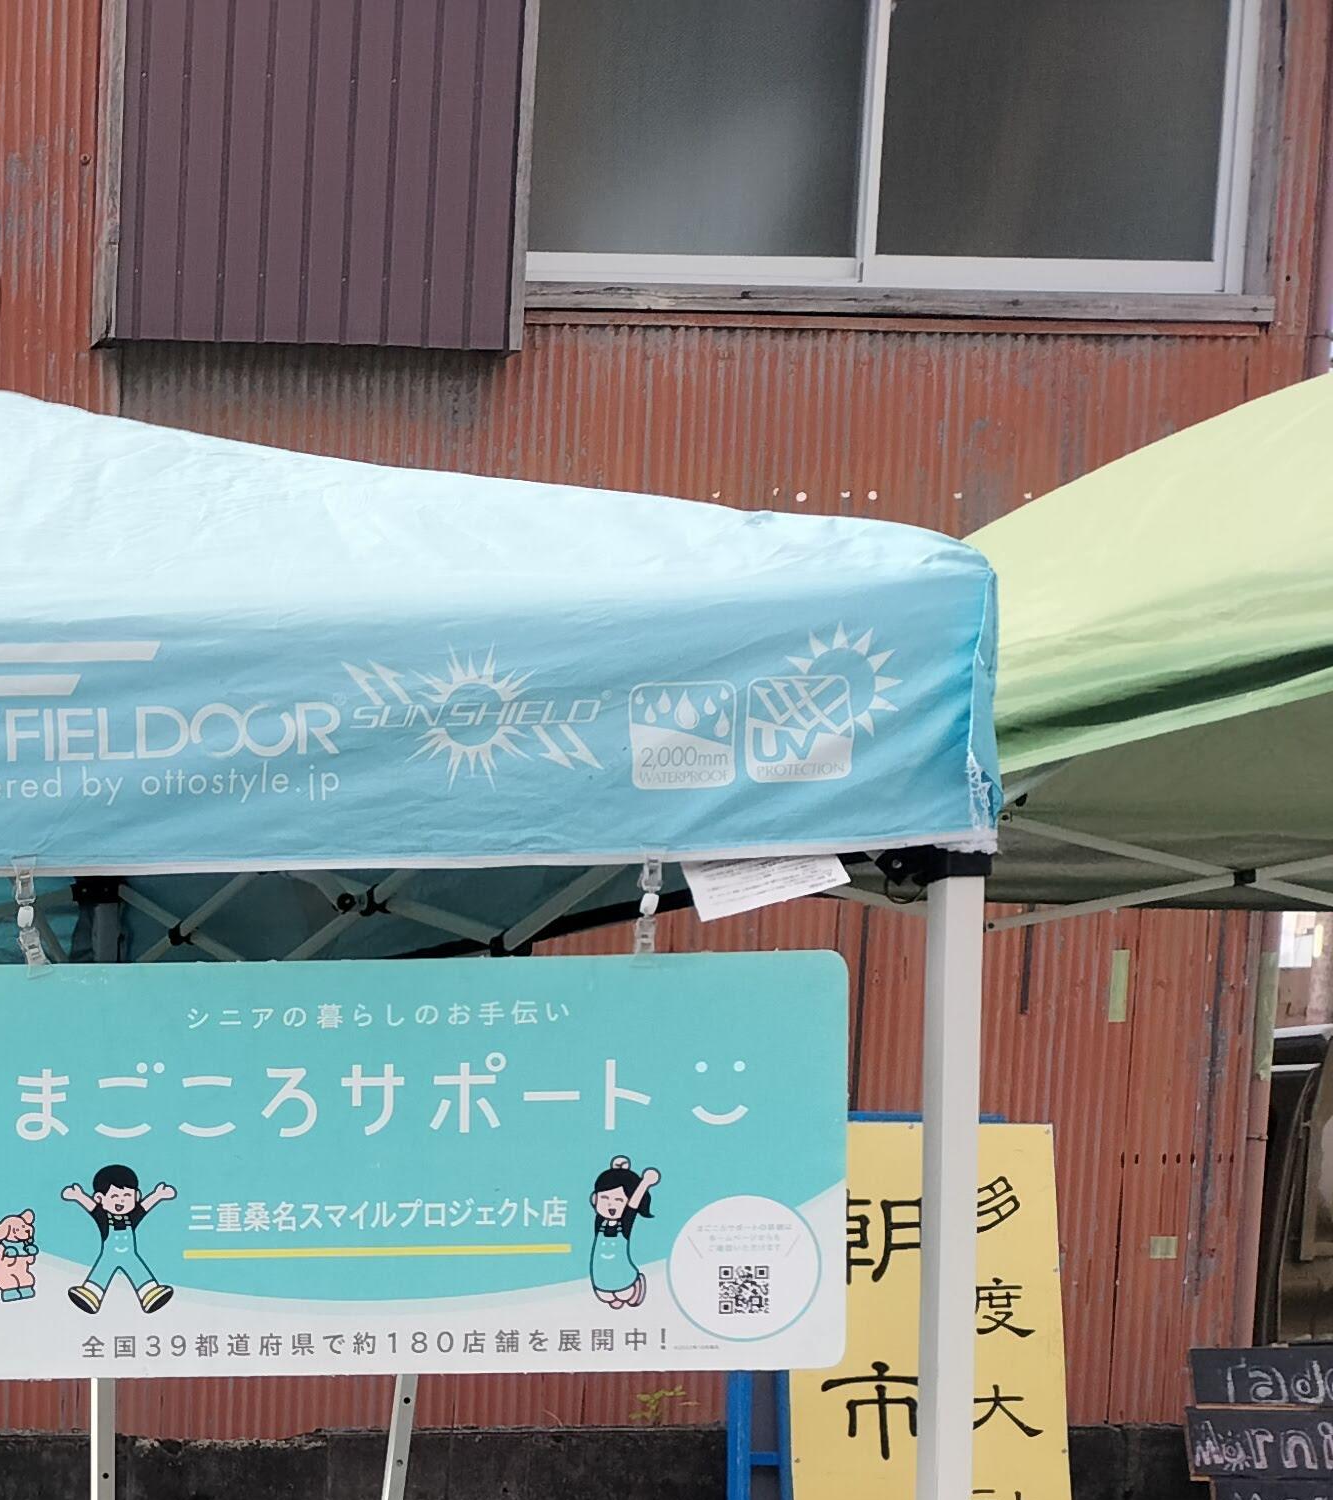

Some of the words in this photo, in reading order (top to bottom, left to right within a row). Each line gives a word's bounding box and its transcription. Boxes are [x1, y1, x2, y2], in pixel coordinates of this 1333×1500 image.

[5, 702, 342, 762] FIELDOOR
[753, 728, 820, 763] UV
[640, 747, 729, 770] 2,000mm
[757, 761, 845, 777] PROTECTION
[81, 766, 124, 805] by
[141, 763, 340, 803] ottostyle.jp
[639, 769, 730, 785] WATERPROOF
[187, 1000, 570, 1030] シニアの暮らしのお手伝い
[16, 1052, 651, 1140] まごころサポート
[188, 1196, 568, 1233] 三重桑名スマイルプロジェクト店
[81, 1329, 668, 1359] 全国39都道府県で約180店舗を展開中！
